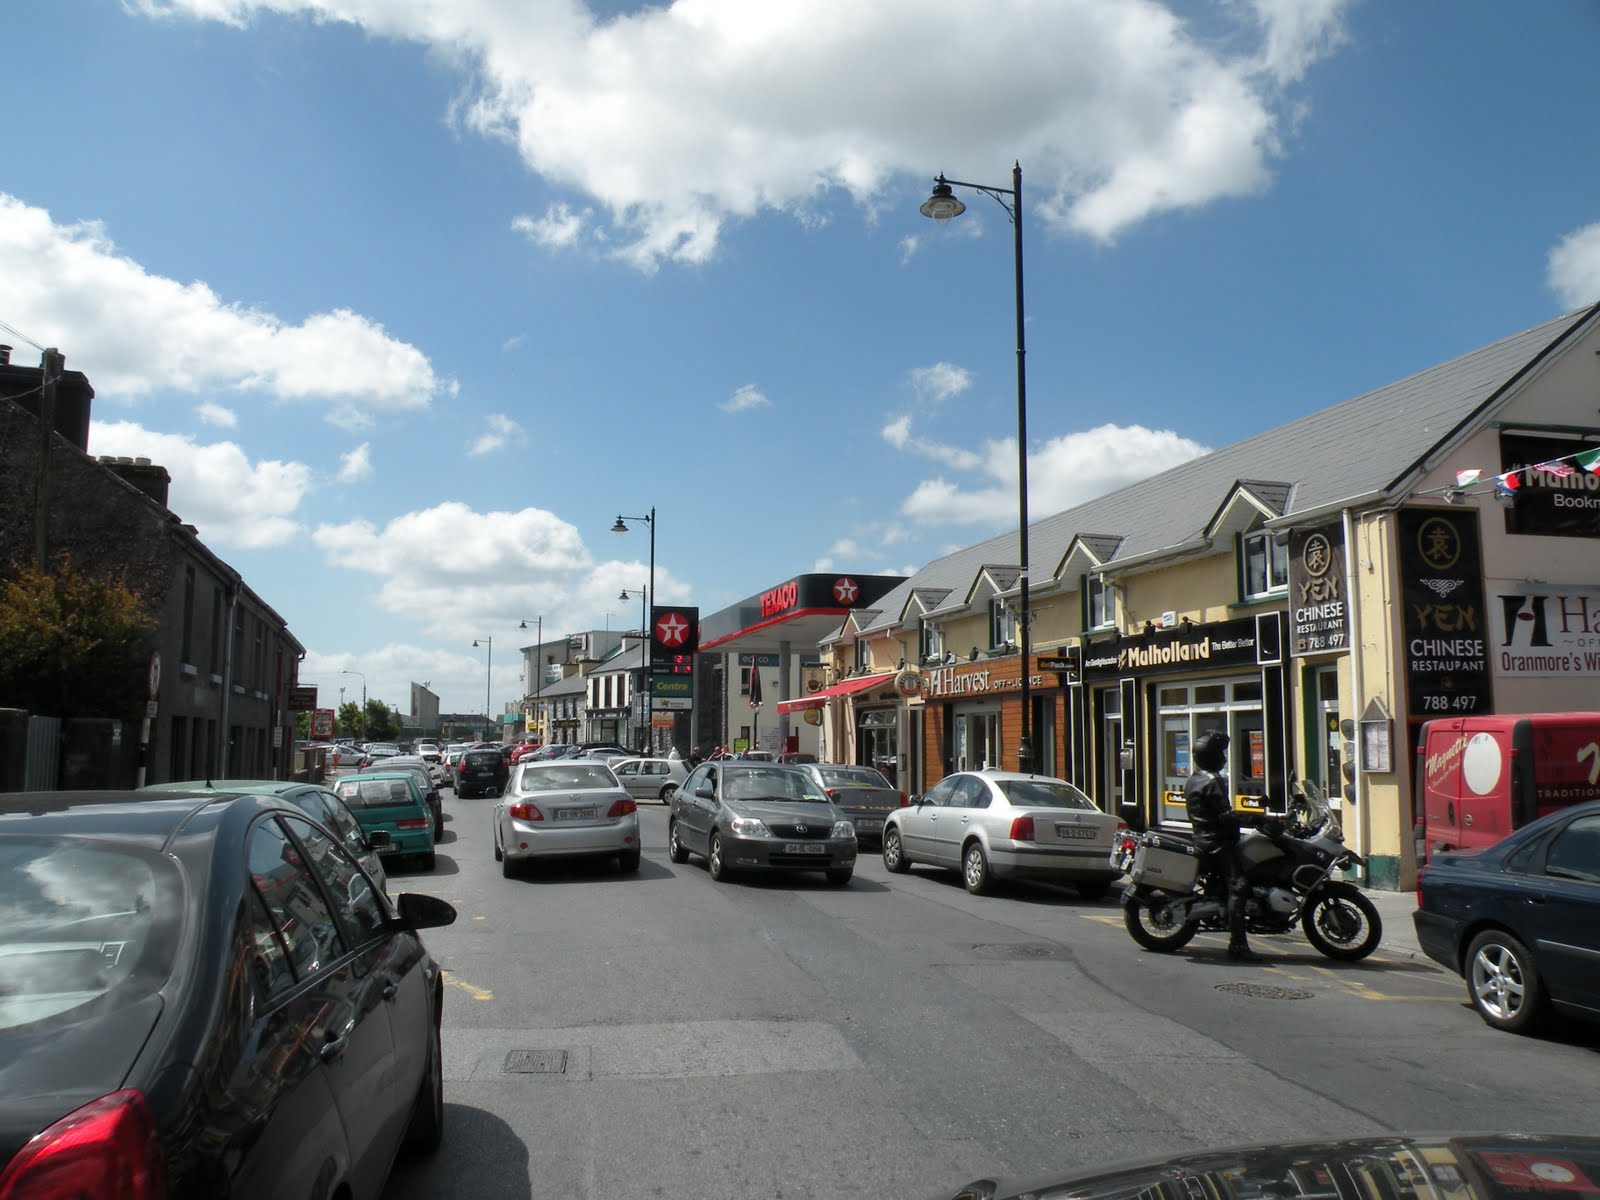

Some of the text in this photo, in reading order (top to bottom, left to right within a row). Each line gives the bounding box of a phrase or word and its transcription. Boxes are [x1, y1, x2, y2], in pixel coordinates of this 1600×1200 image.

[760, 581, 798, 618] TEXACO
[1299, 576, 1338, 603] YEN
[1296, 602, 1343, 622] CHINESE
[1414, 604, 1476, 632] YEN
[1297, 619, 1343, 634] RESTAURANT
[1309, 634, 1344, 649] 788 497
[1411, 639, 1483, 657] CHINESE
[1128, 637, 1210, 668] Mulholland
[1211, 642, 1221, 650] The
[1222, 641, 1237, 650] Better
[1502, 651, 1581, 671] Oranmore's
[1412, 660, 1484, 671] RESTAURANT
[656, 682, 688, 691] Centra
[942, 667, 990, 695] Harvest
[1424, 696, 1476, 709] 788 497
